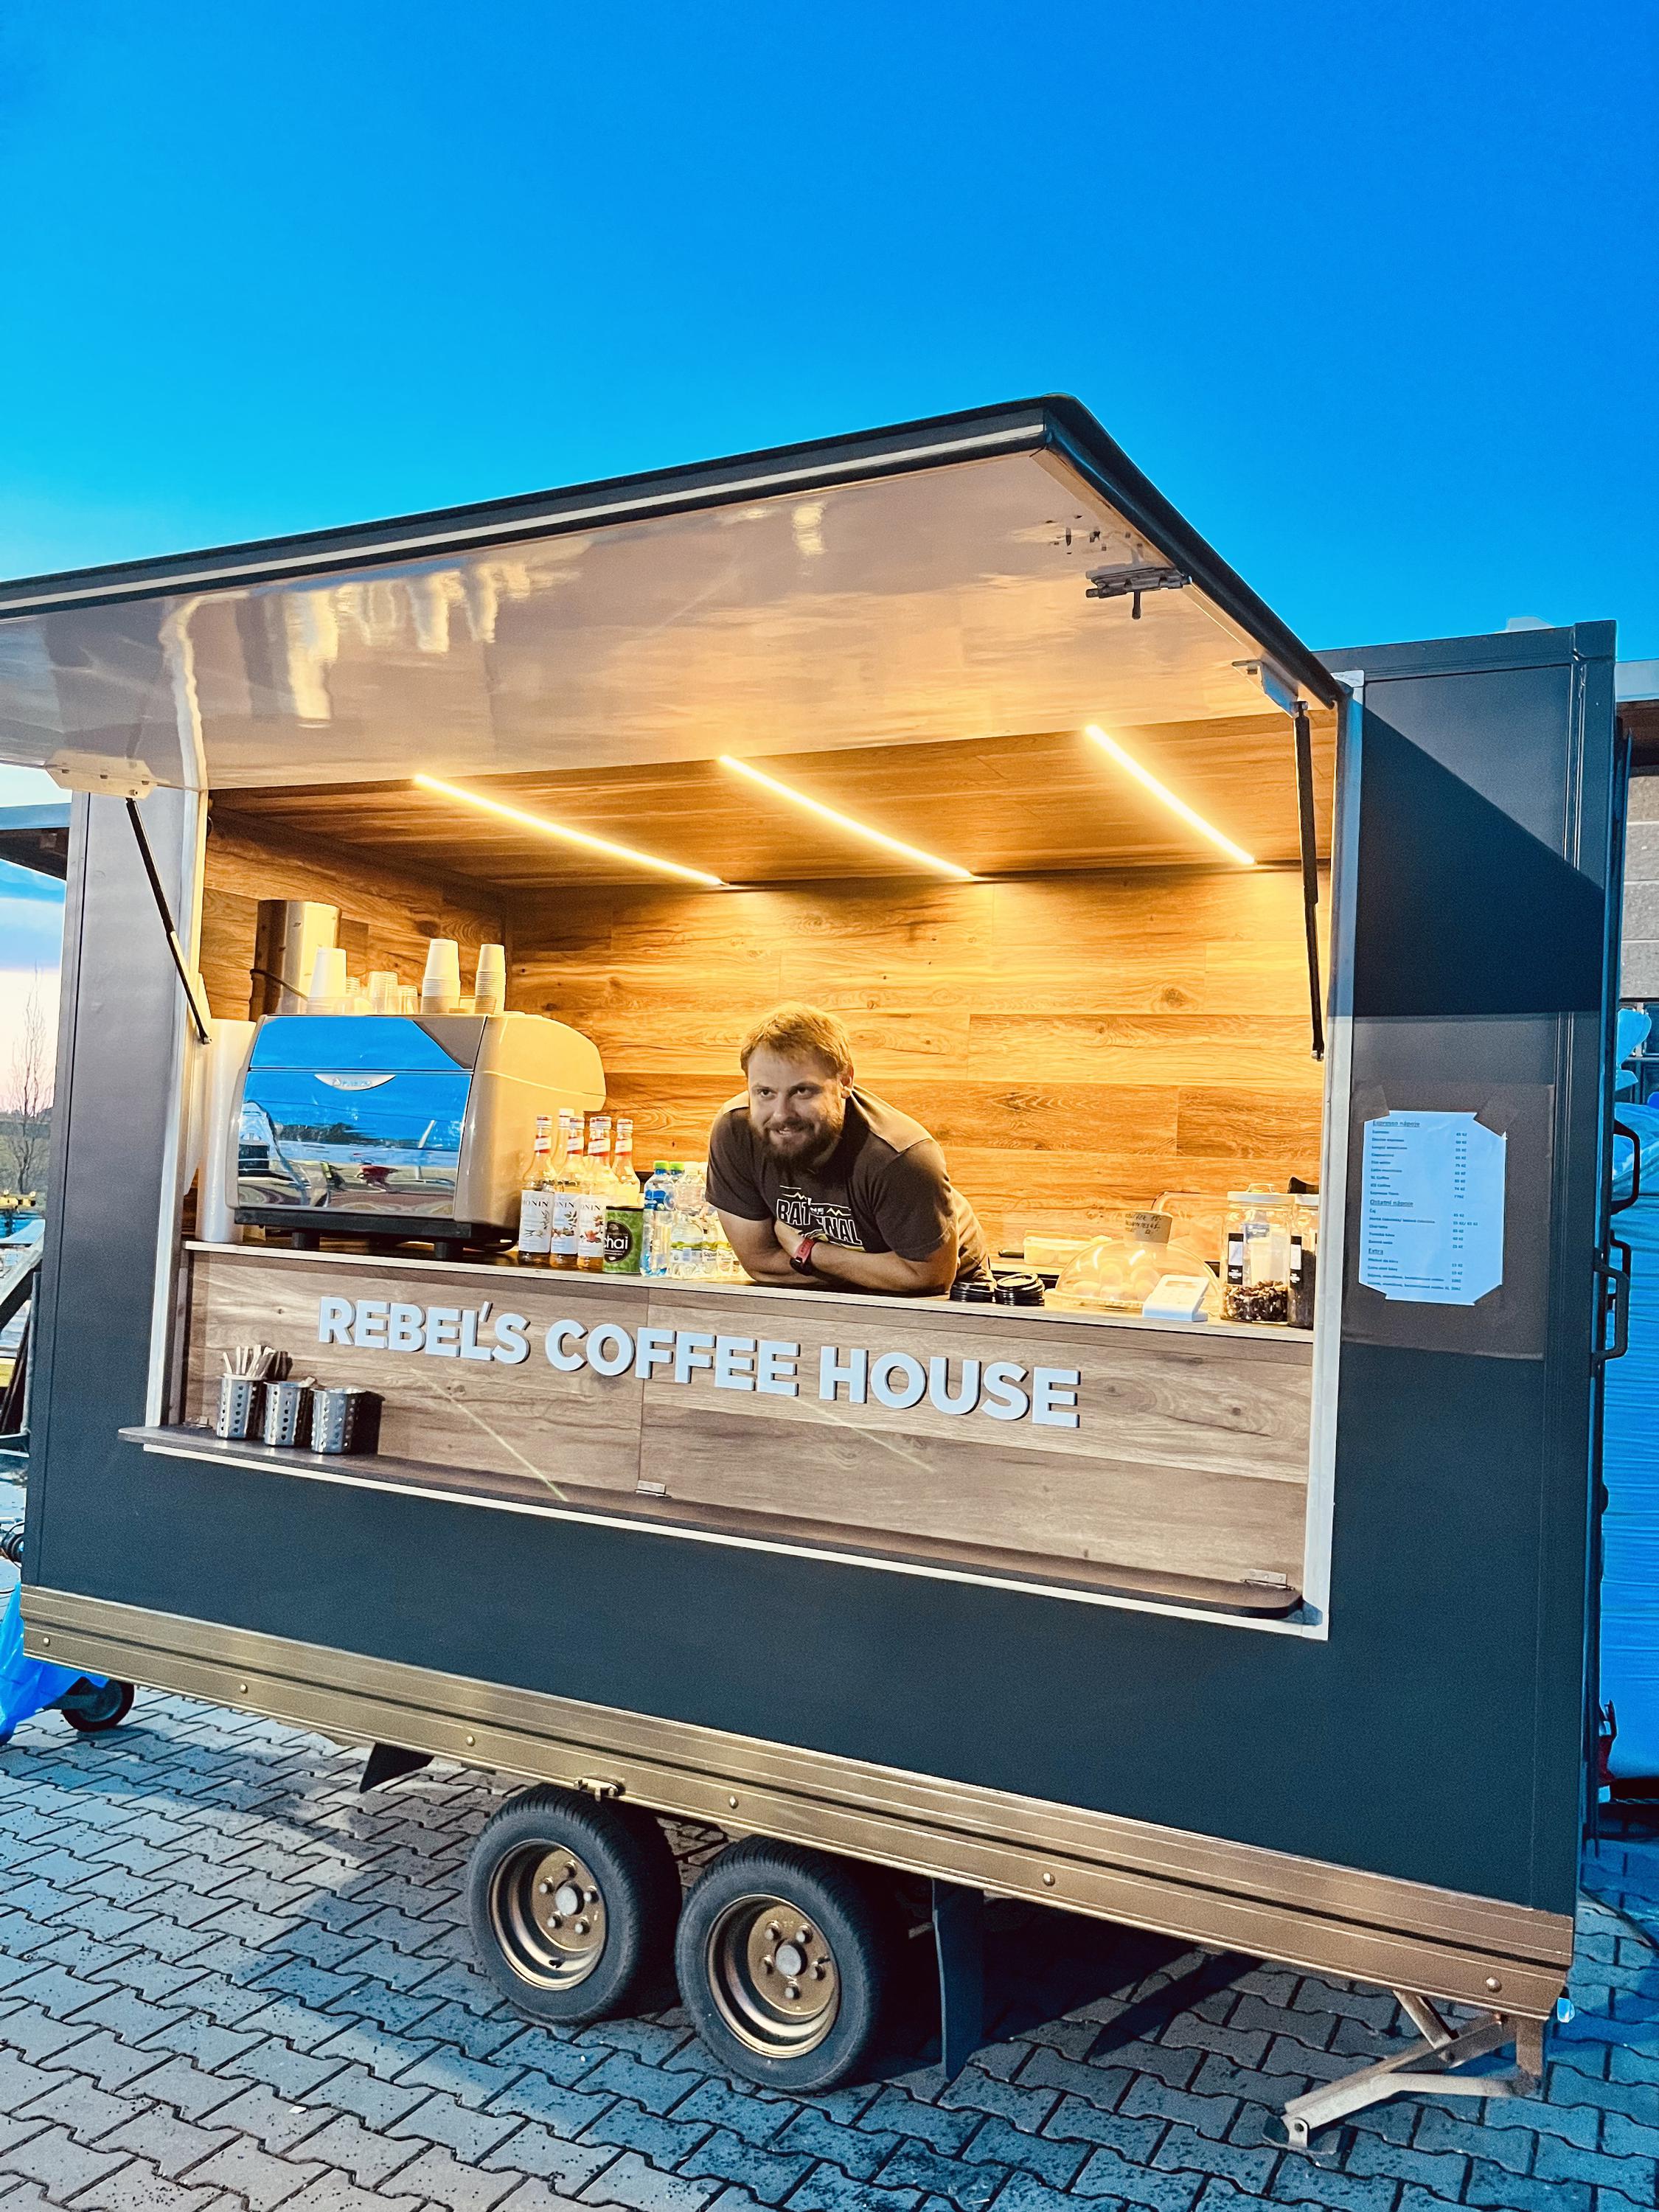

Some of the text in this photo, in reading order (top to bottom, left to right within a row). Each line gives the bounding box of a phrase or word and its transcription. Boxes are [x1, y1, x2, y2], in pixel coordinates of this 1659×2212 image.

[524, 1199, 549, 1207] ONIN
[319, 1297, 1081, 1428] REBEL'S COFFEE HOUSE
